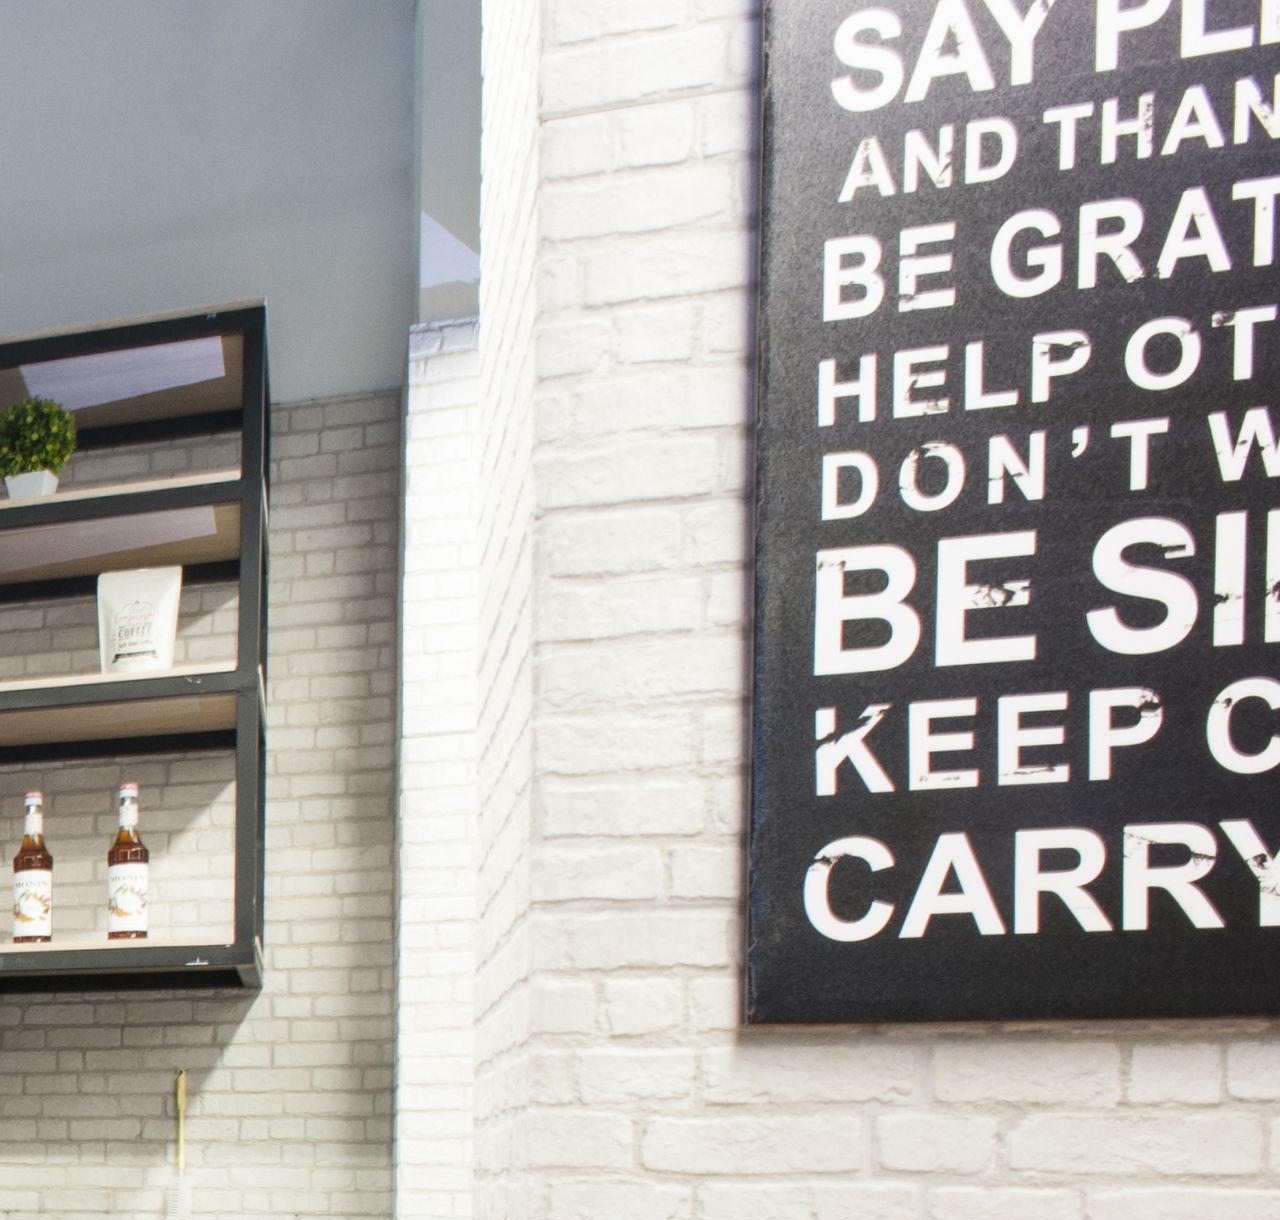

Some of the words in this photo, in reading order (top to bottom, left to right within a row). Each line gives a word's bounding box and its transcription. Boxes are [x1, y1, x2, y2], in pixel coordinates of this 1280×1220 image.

[831, 0, 1047, 112] SAY
[1095, 0, 1280, 73] PL
[838, 115, 1019, 204] AND
[1043, 73, 1280, 170] THAN
[822, 221, 956, 322] BE
[990, 176, 1280, 298] GRAT
[817, 330, 1091, 428] HELP
[1125, 305, 1278, 390] OT
[821, 417, 1170, 521] DON'T
[813, 530, 1037, 676] BE
[1086, 510, 1280, 655] SI
[815, 688, 1163, 796] KEEP
[803, 821, 1280, 942] CARRY
